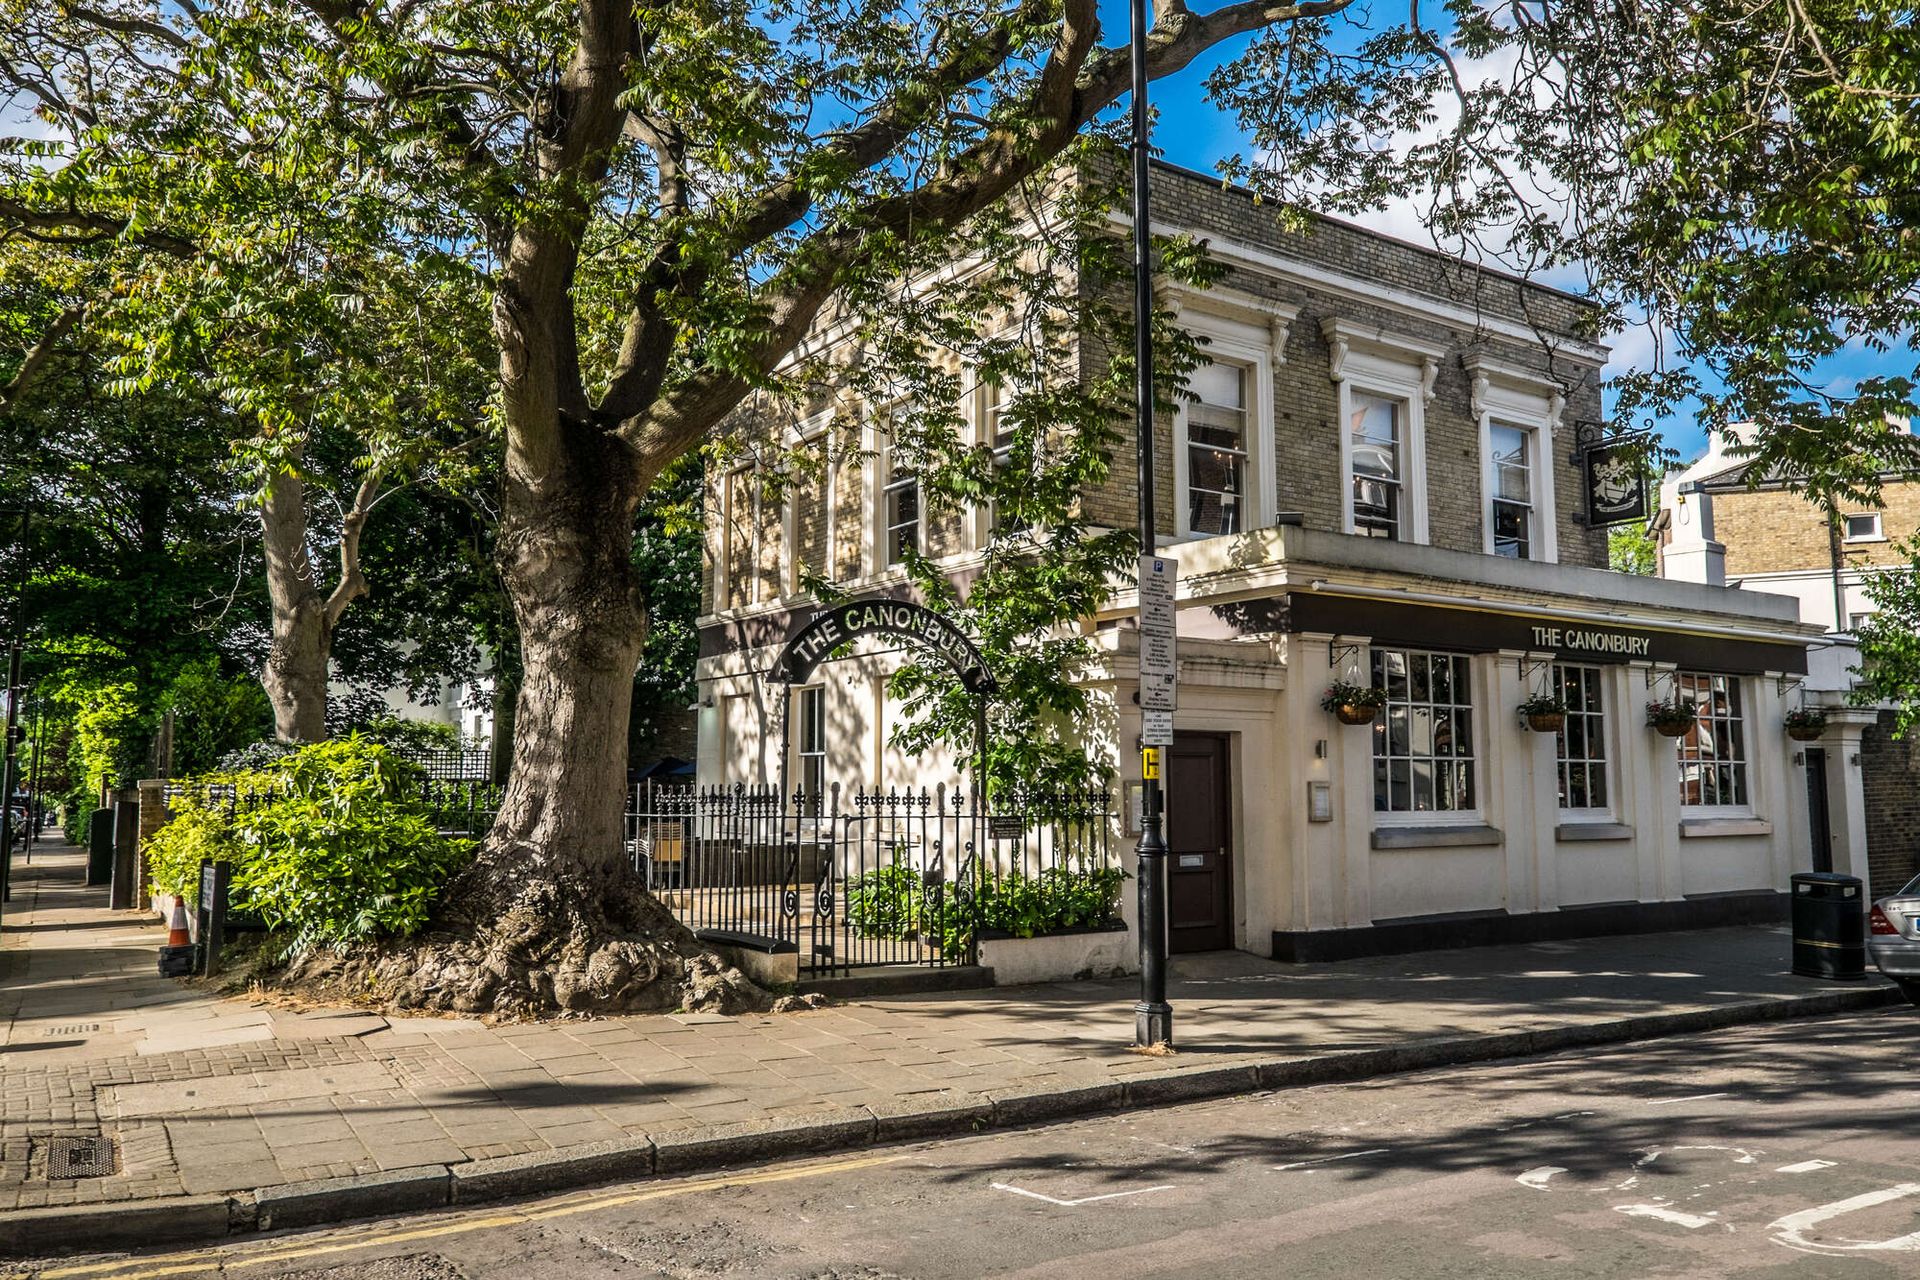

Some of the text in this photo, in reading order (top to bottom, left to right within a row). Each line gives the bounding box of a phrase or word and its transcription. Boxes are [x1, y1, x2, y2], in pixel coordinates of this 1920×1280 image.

[793, 605, 978, 673] THE CANONBURY
[1531, 626, 1650, 655] THE CANONBURY
